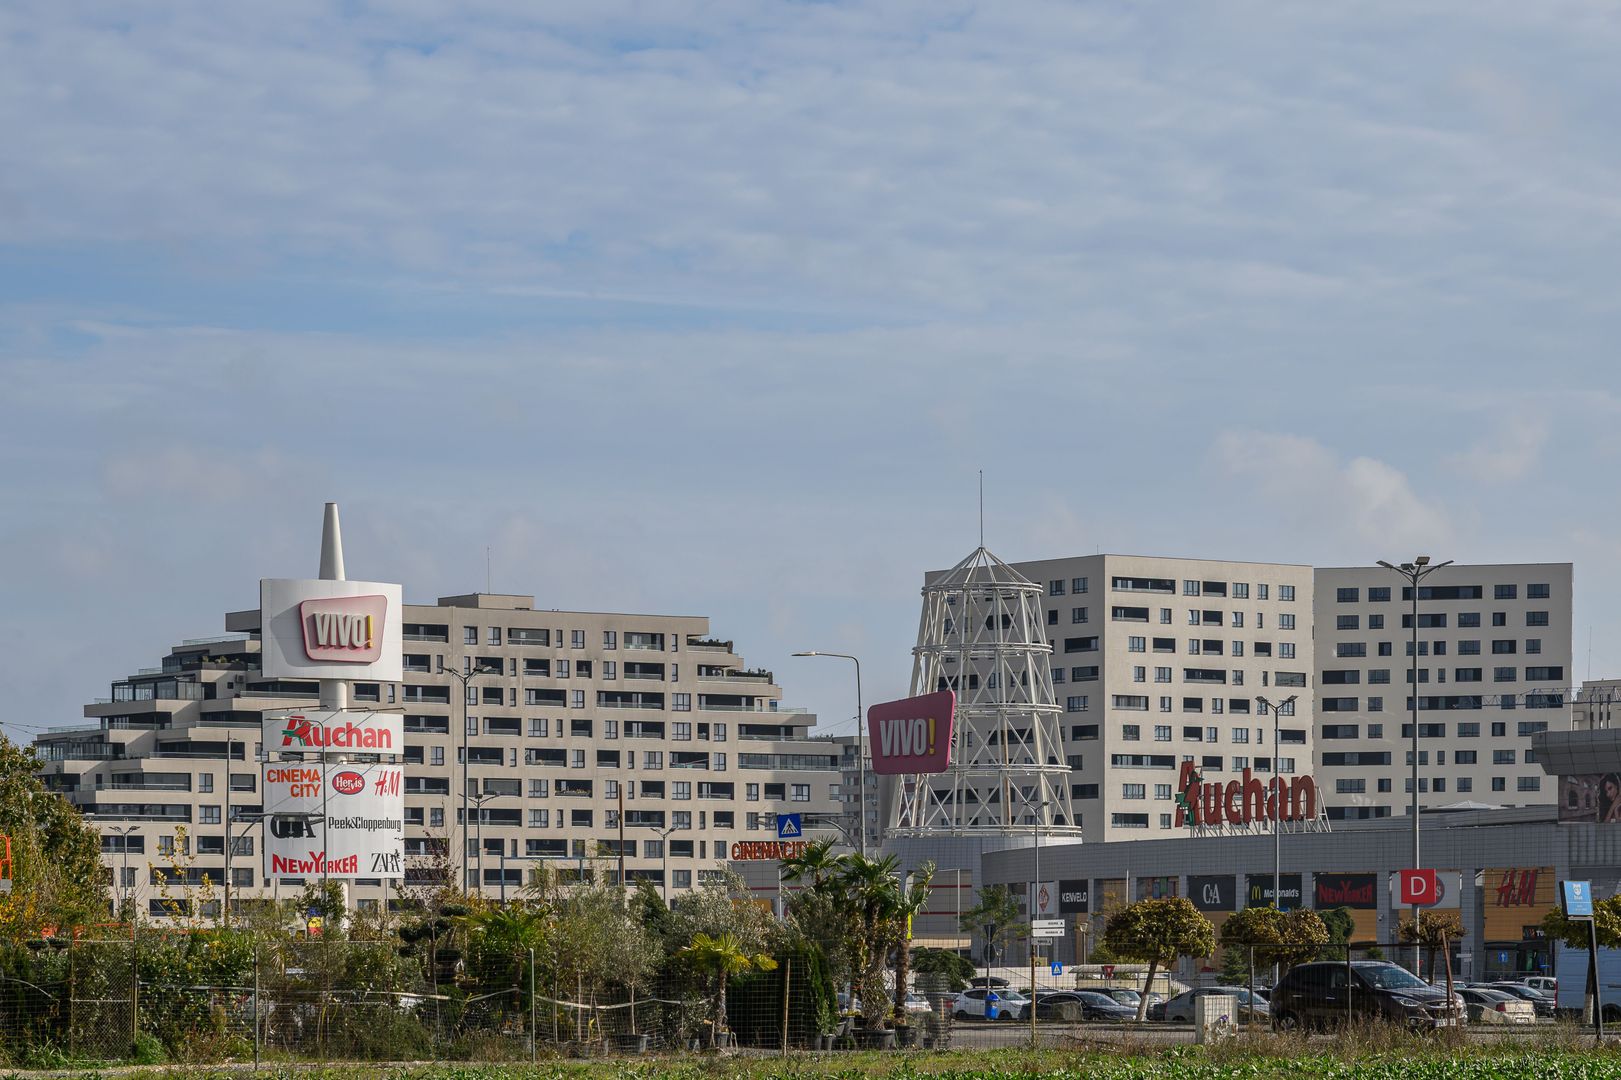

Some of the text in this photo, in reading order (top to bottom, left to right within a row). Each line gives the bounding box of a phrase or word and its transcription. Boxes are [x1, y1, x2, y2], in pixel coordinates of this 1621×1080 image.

[313, 612, 374, 648] VIVO!
[282, 715, 392, 749] Auchan
[879, 718, 936, 757] VIVO!
[266, 769, 321, 783] CINEMA
[336, 776, 363, 790] Hervis
[375, 770, 401, 797] H&M
[290, 784, 321, 797] CITY
[1175, 760, 1317, 828] Auchan
[731, 841, 782, 860] CINEMA
[1202, 883, 1221, 904] C&A
[1410, 876, 1427, 896] D
[1061, 891, 1087, 902] KENVELO
